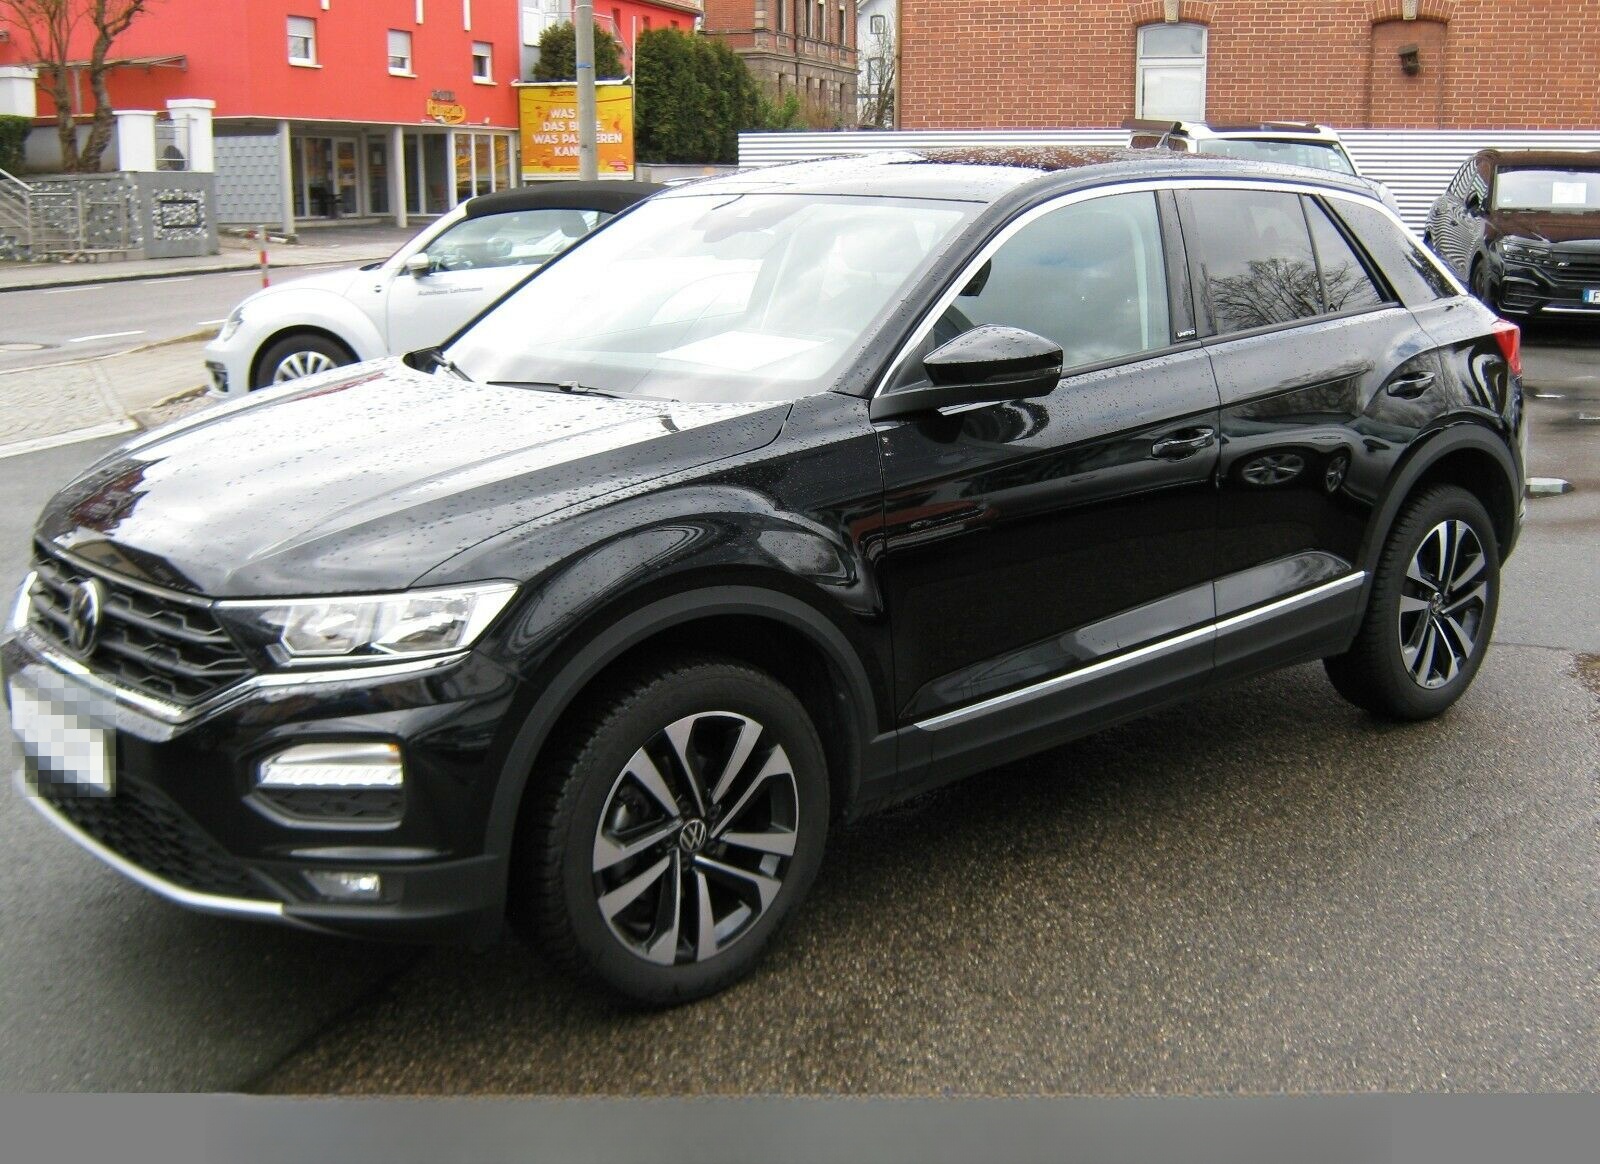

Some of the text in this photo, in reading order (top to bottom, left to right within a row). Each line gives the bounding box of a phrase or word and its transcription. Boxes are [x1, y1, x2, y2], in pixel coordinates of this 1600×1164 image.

[550, 108, 576, 119] WAS
[543, 121, 566, 132] DAS
[532, 134, 559, 145] WAS
[554, 146, 580, 157] KAN
